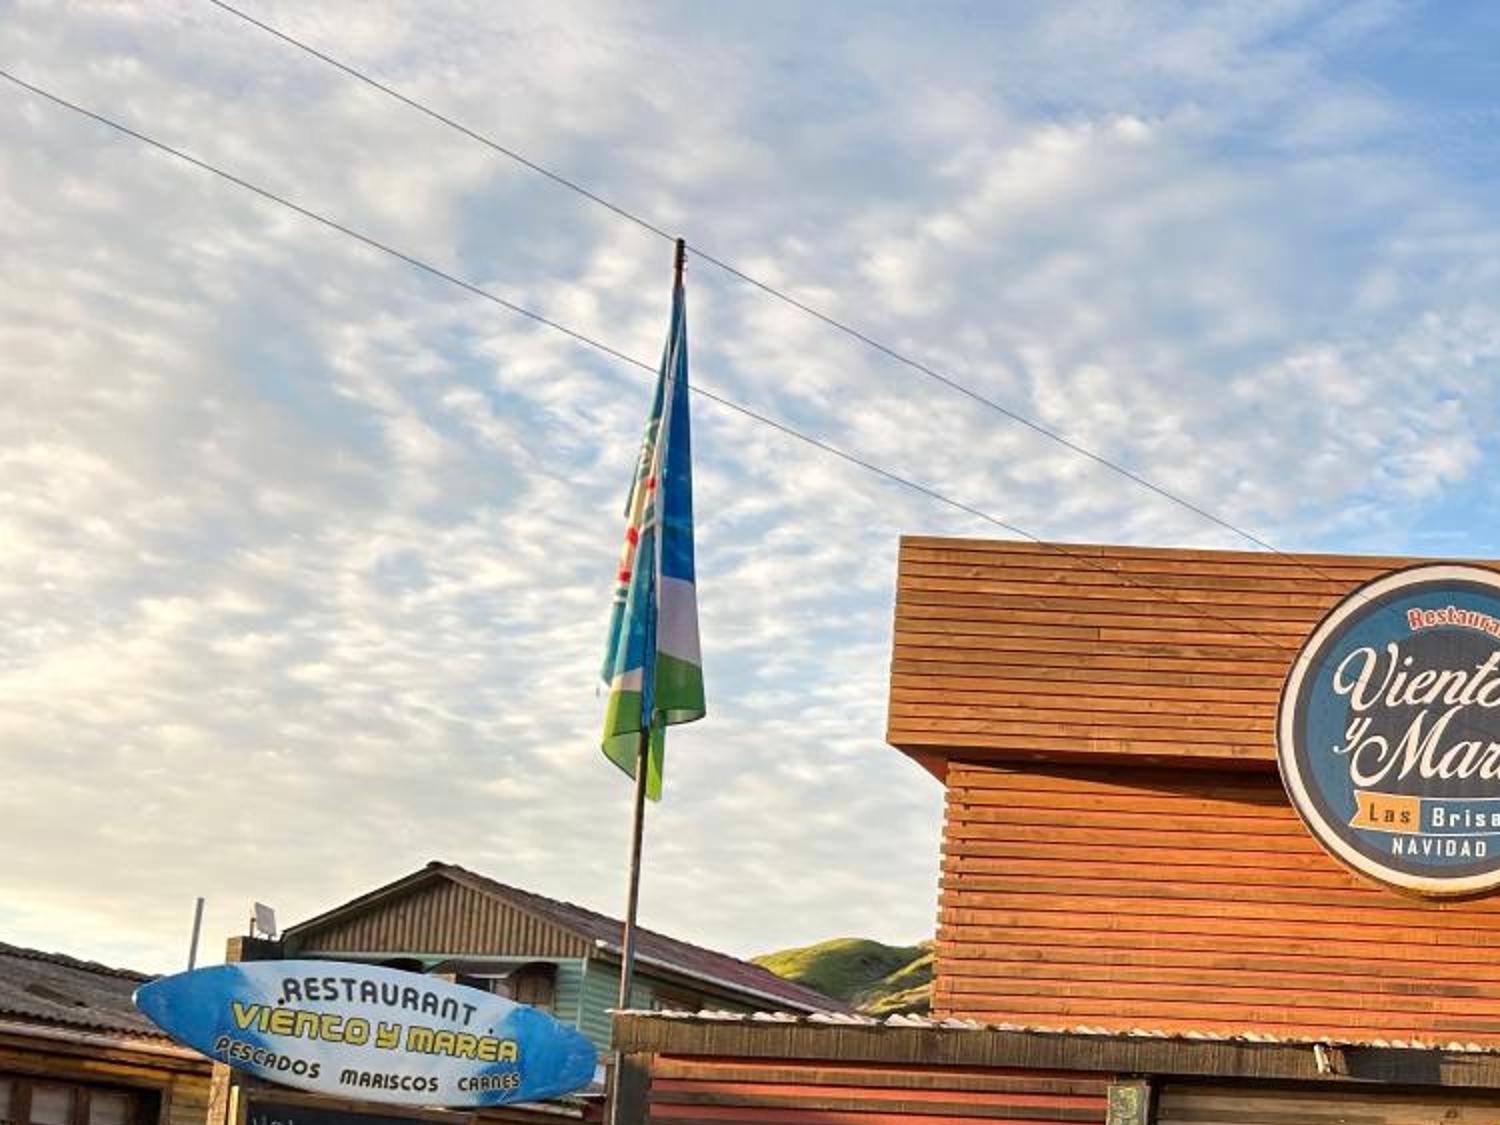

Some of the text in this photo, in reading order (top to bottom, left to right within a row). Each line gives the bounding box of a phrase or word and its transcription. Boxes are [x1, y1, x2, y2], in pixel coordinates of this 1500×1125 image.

[1333, 717, 1372, 753] y
[1370, 803, 1411, 824] Las
[1392, 837, 1487, 857] NAVIDAD
[282, 977, 477, 1026] RESTAURANT
[231, 1001, 519, 1063] VIENTO Y MAREA
[215, 1036, 521, 1093] PESCADOS MARISCOS CARNES
